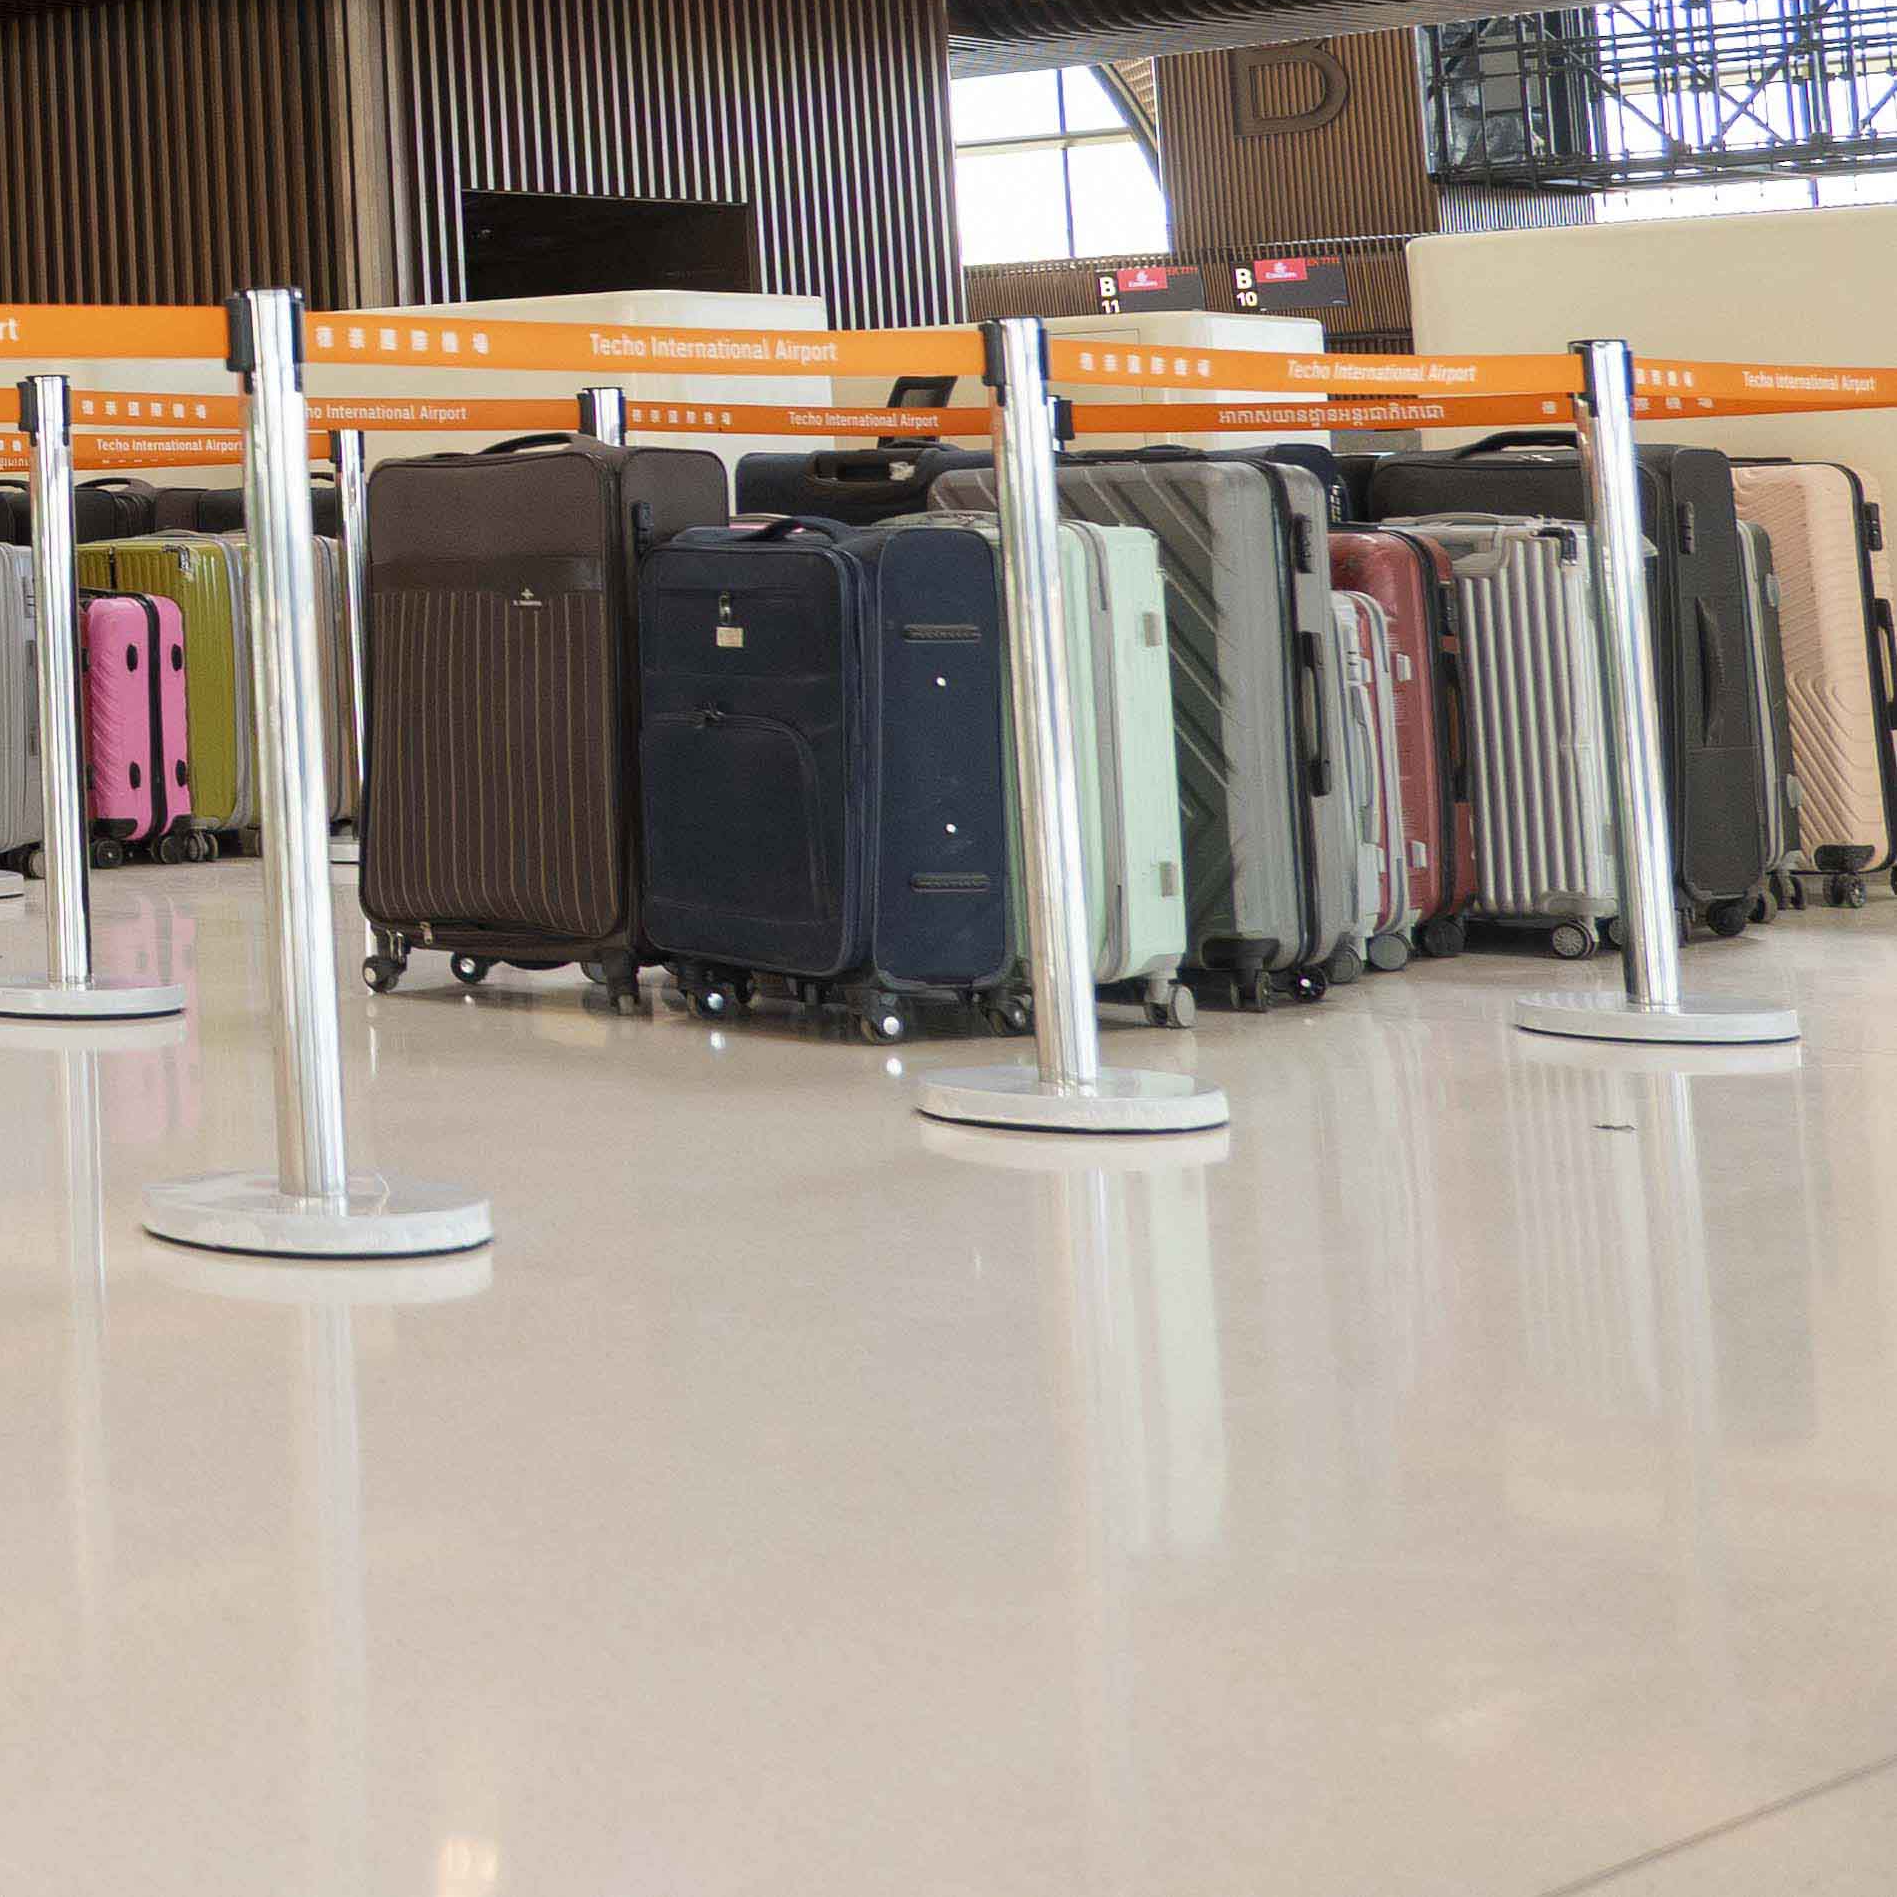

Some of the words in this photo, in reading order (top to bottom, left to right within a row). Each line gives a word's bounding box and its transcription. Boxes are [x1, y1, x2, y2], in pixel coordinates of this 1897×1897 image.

[1099, 276, 1116, 297] B
[1234, 268, 1253, 289] B
[1101, 299, 1121, 314] 11
[1236, 291, 1258, 307] 10
[590, 333, 647, 357] Techo
[651, 337, 770, 359] International
[775, 339, 838, 365] Airport
[1288, 359, 1331, 379] Techo
[1332, 363, 1425, 382] International
[1426, 364, 1476, 384] Airport
[327, 405, 414, 419] International
[419, 406, 467, 423] Airport
[788, 412, 823, 425] Techo
[825, 413, 898, 427] International
[898, 414, 938, 429] Airport
[97, 439, 130, 451] Techo
[132, 439, 203, 451] International
